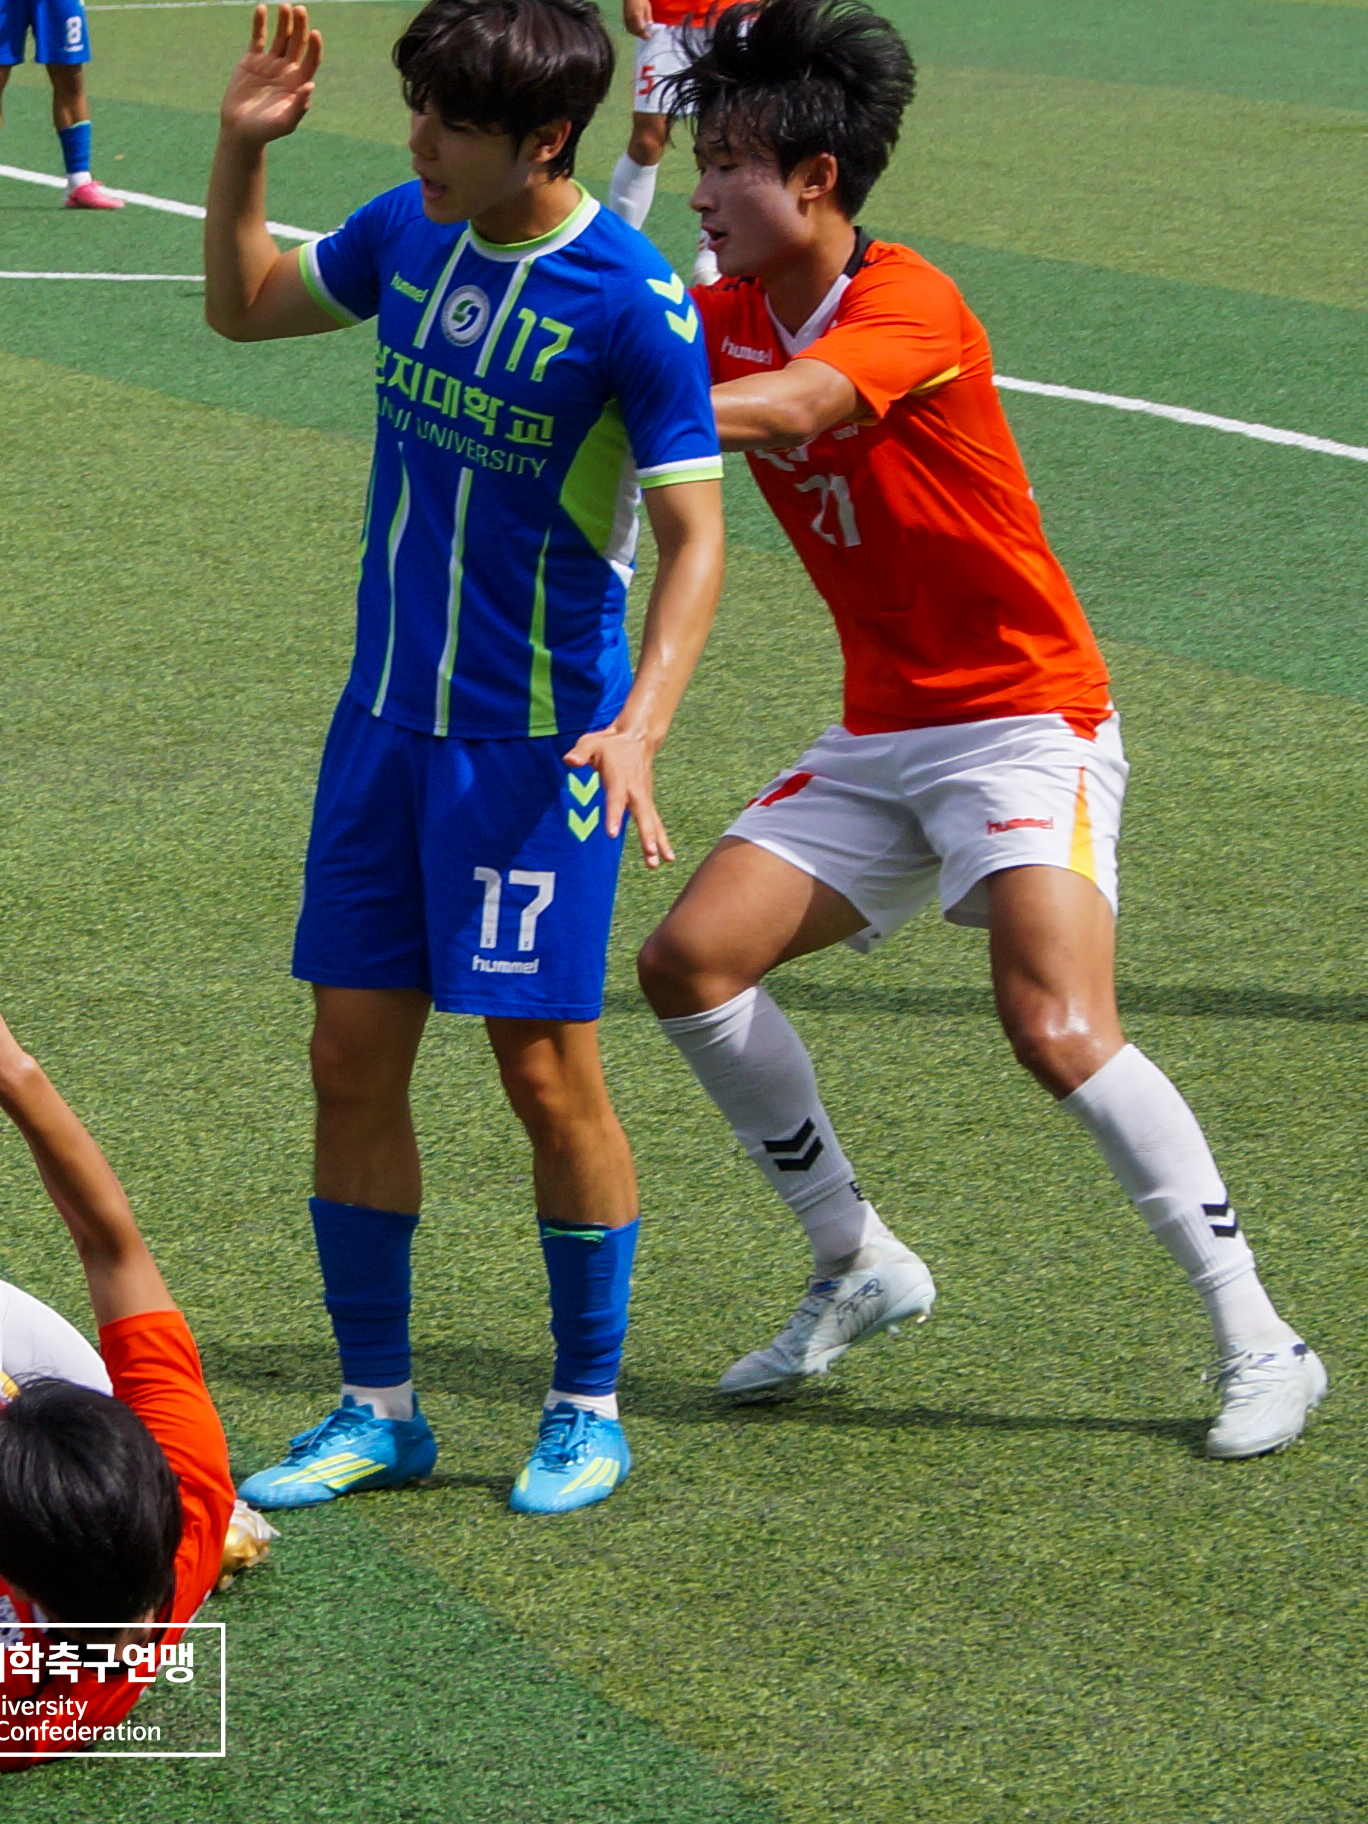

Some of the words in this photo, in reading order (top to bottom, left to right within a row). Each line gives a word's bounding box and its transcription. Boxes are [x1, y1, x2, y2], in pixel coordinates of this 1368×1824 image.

[66, 16, 82, 44] 8
[390, 270, 429, 303] hummel
[504, 307, 575, 383] 17
[416, 416, 548, 479] UNIVERSITY
[794, 472, 863, 548] 21
[473, 866, 556, 951] 17
[472, 954, 540, 974] hummel
